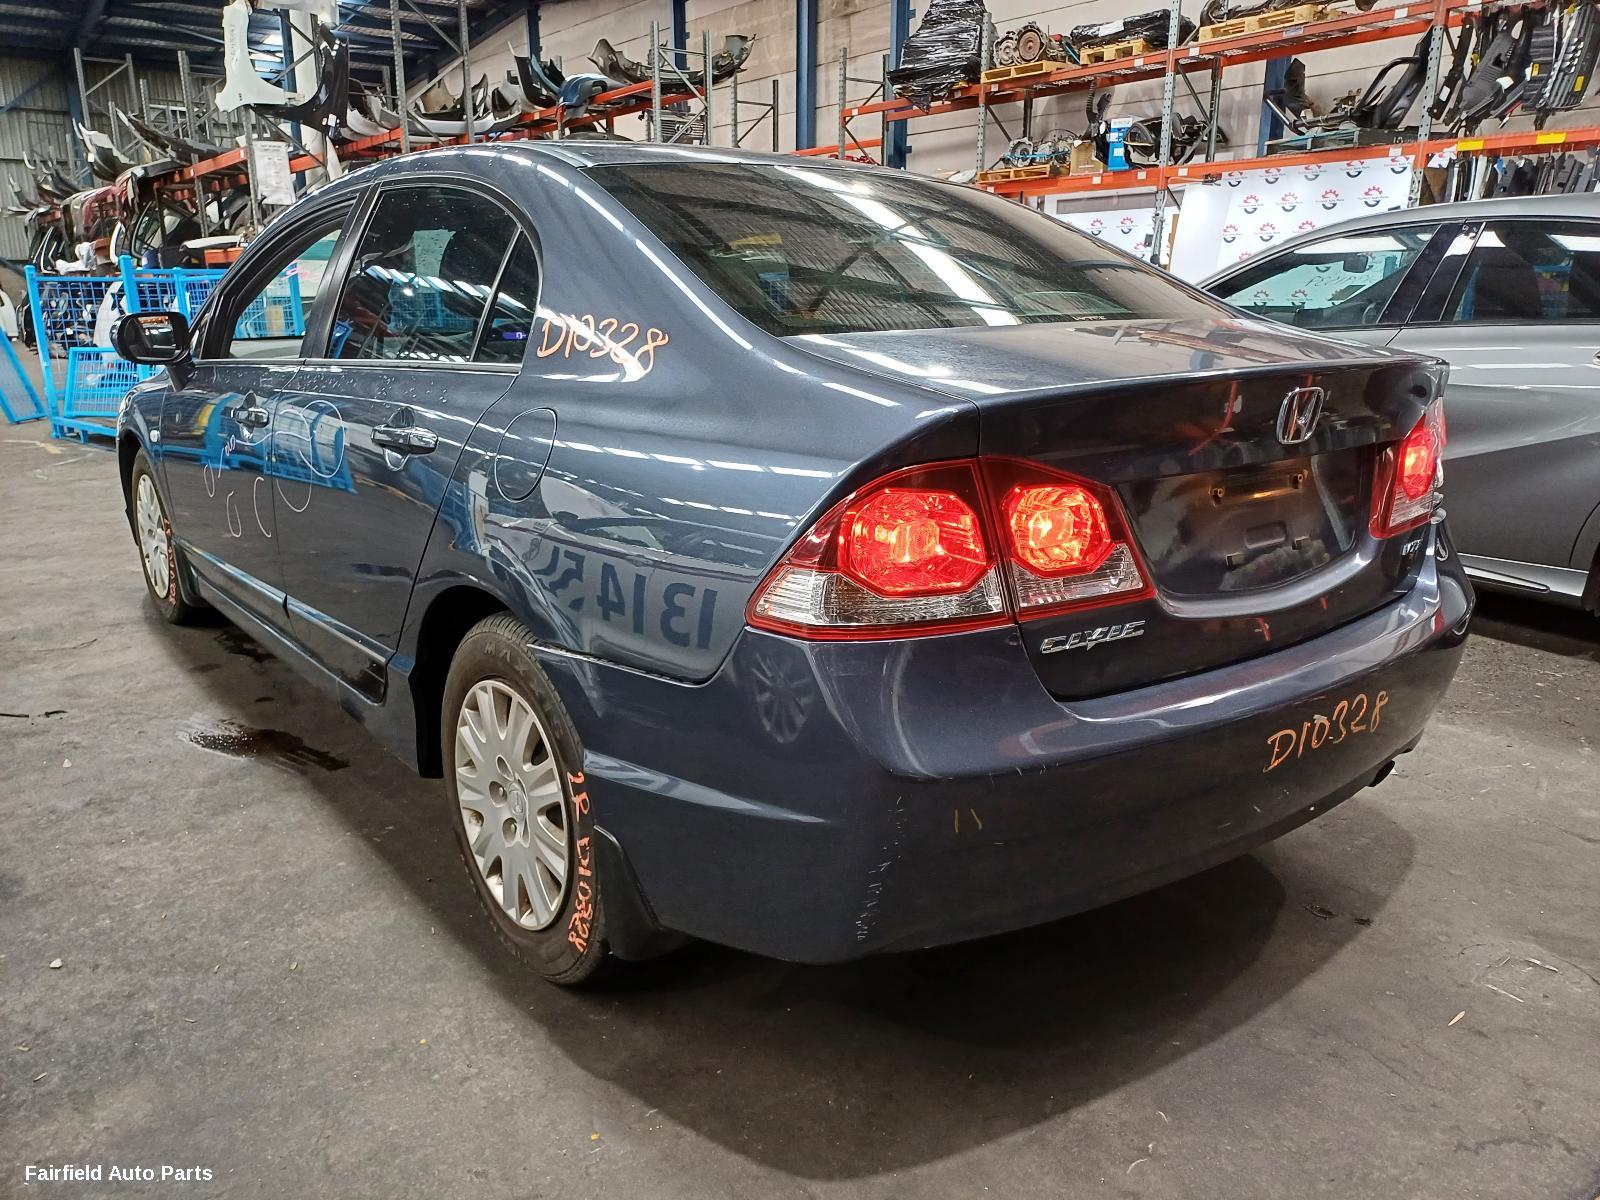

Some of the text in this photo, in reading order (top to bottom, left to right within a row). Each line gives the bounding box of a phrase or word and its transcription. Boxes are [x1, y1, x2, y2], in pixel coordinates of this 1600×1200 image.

[537, 314, 669, 374] D10328
[1040, 620, 1146, 653] CIVIC
[1263, 690, 1389, 773] D10328
